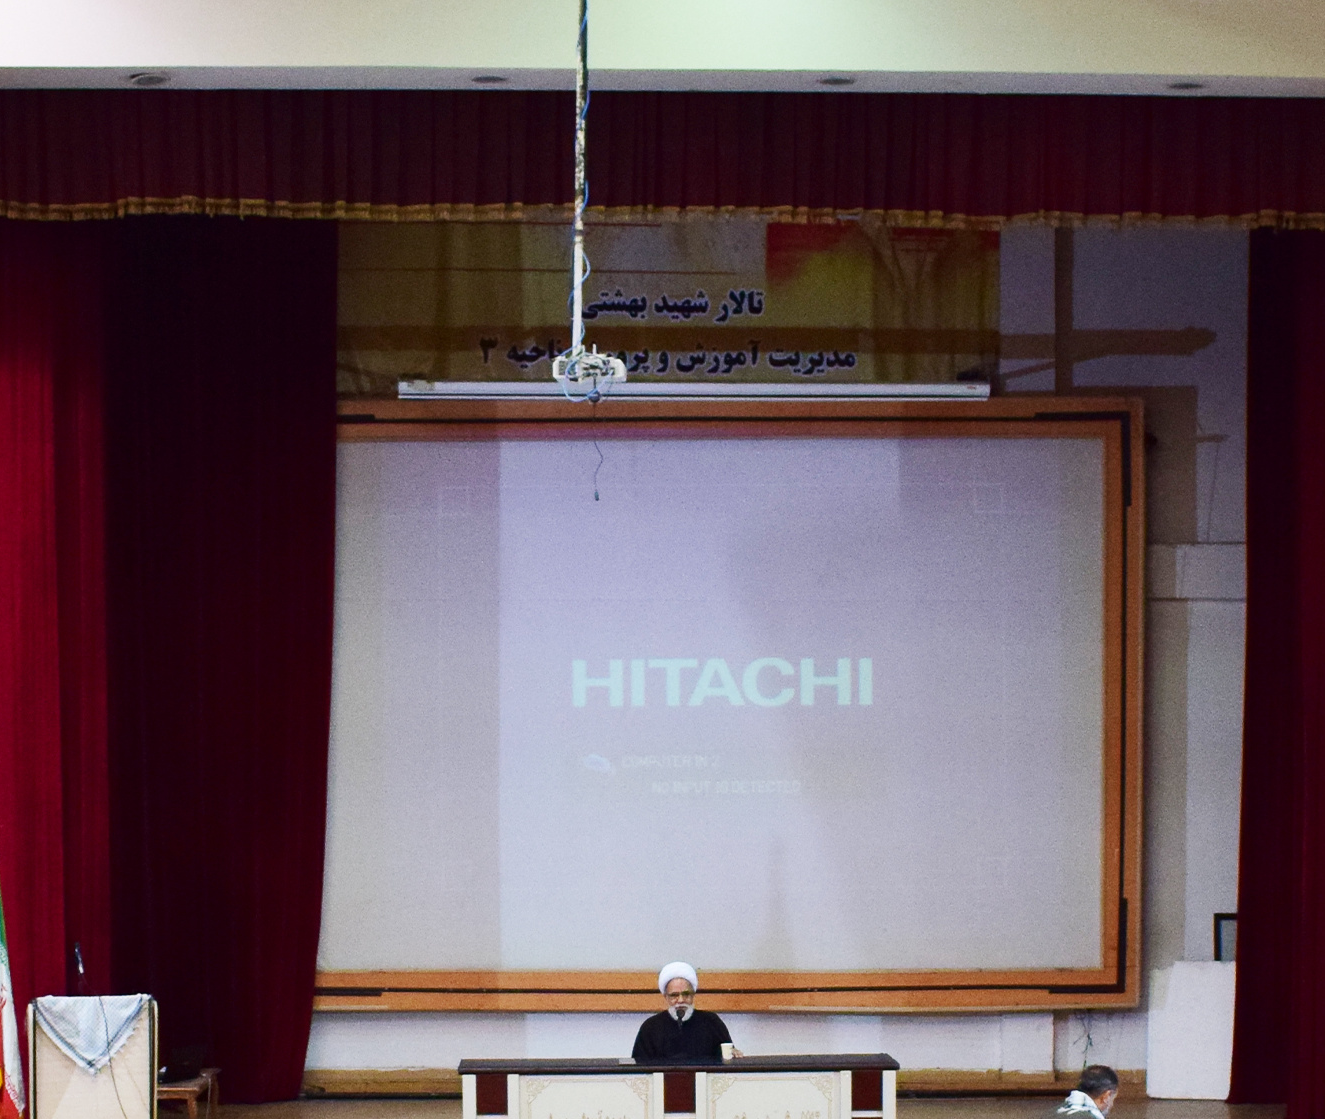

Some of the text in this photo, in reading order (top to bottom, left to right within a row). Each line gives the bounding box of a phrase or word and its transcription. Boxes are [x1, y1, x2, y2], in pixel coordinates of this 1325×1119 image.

[580, 289, 765, 322] تالار شهید بهشتی
[655, 350, 669, 373] و
[676, 340, 760, 373] آموزش
[769, 345, 857, 374] مدیریت
[573, 657, 873, 706] HITACHI
